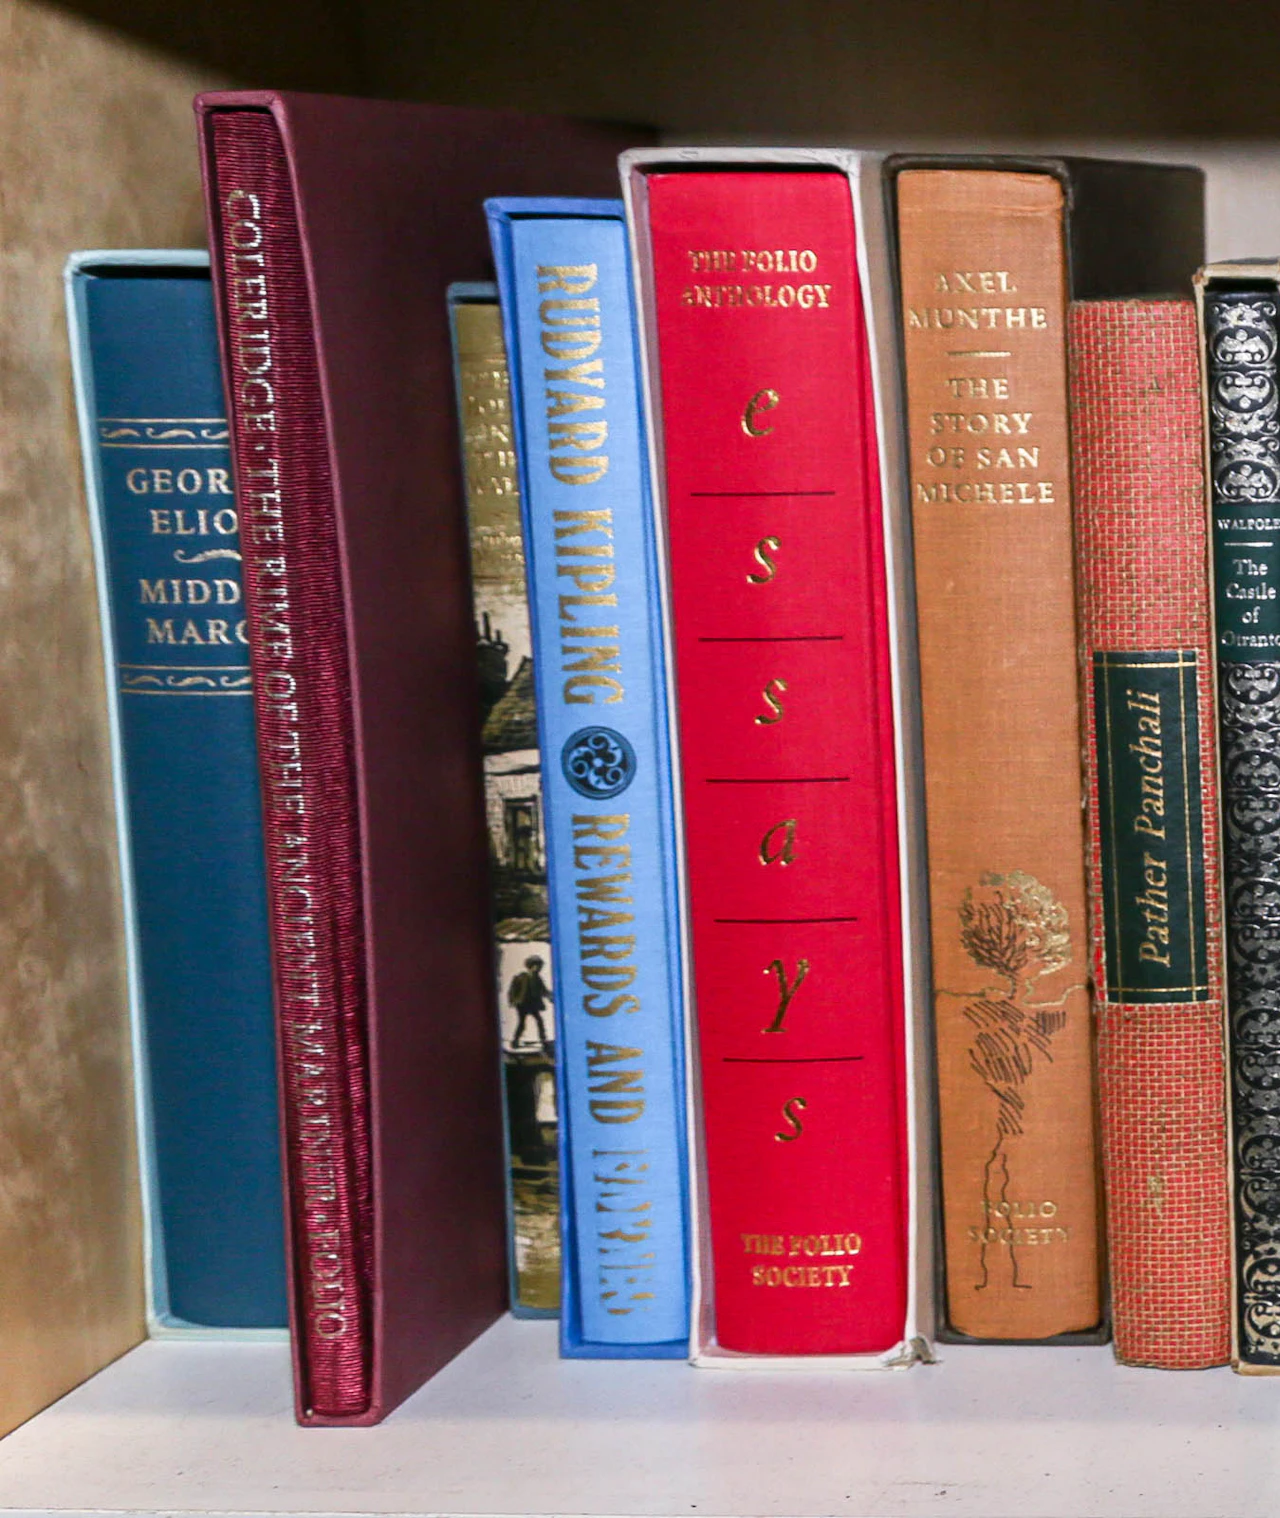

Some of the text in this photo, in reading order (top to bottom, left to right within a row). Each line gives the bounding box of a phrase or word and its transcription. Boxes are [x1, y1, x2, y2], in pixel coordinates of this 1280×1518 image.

[688, 250, 818, 272] THE FOLIO
[936, 271, 1017, 293] AXEL
[680, 284, 832, 308] ANTHOLOGY
[908, 307, 1047, 330] MUNTHE
[945, 378, 1009, 400] THE
[930, 412, 1032, 435] STORY
[977, 446, 1040, 469] SAN
[126, 467, 233, 494] GEOR
[247, 458, 285, 544] THE
[916, 482, 1054, 504] MICHELE
[150, 509, 238, 535] ELIO
[1233, 559, 1268, 575] The
[139, 578, 241, 604] MIDD
[1226, 582, 1277, 600] Castle
[1242, 606, 1260, 624] of
[536, 263, 647, 1126] RUDYARD KIPLING REWARDS AND
[1126, 688, 1171, 968] Pather Panchali
[741, 1232, 862, 1257] THE FOLIO
[752, 1264, 853, 1288] SOCIETY
